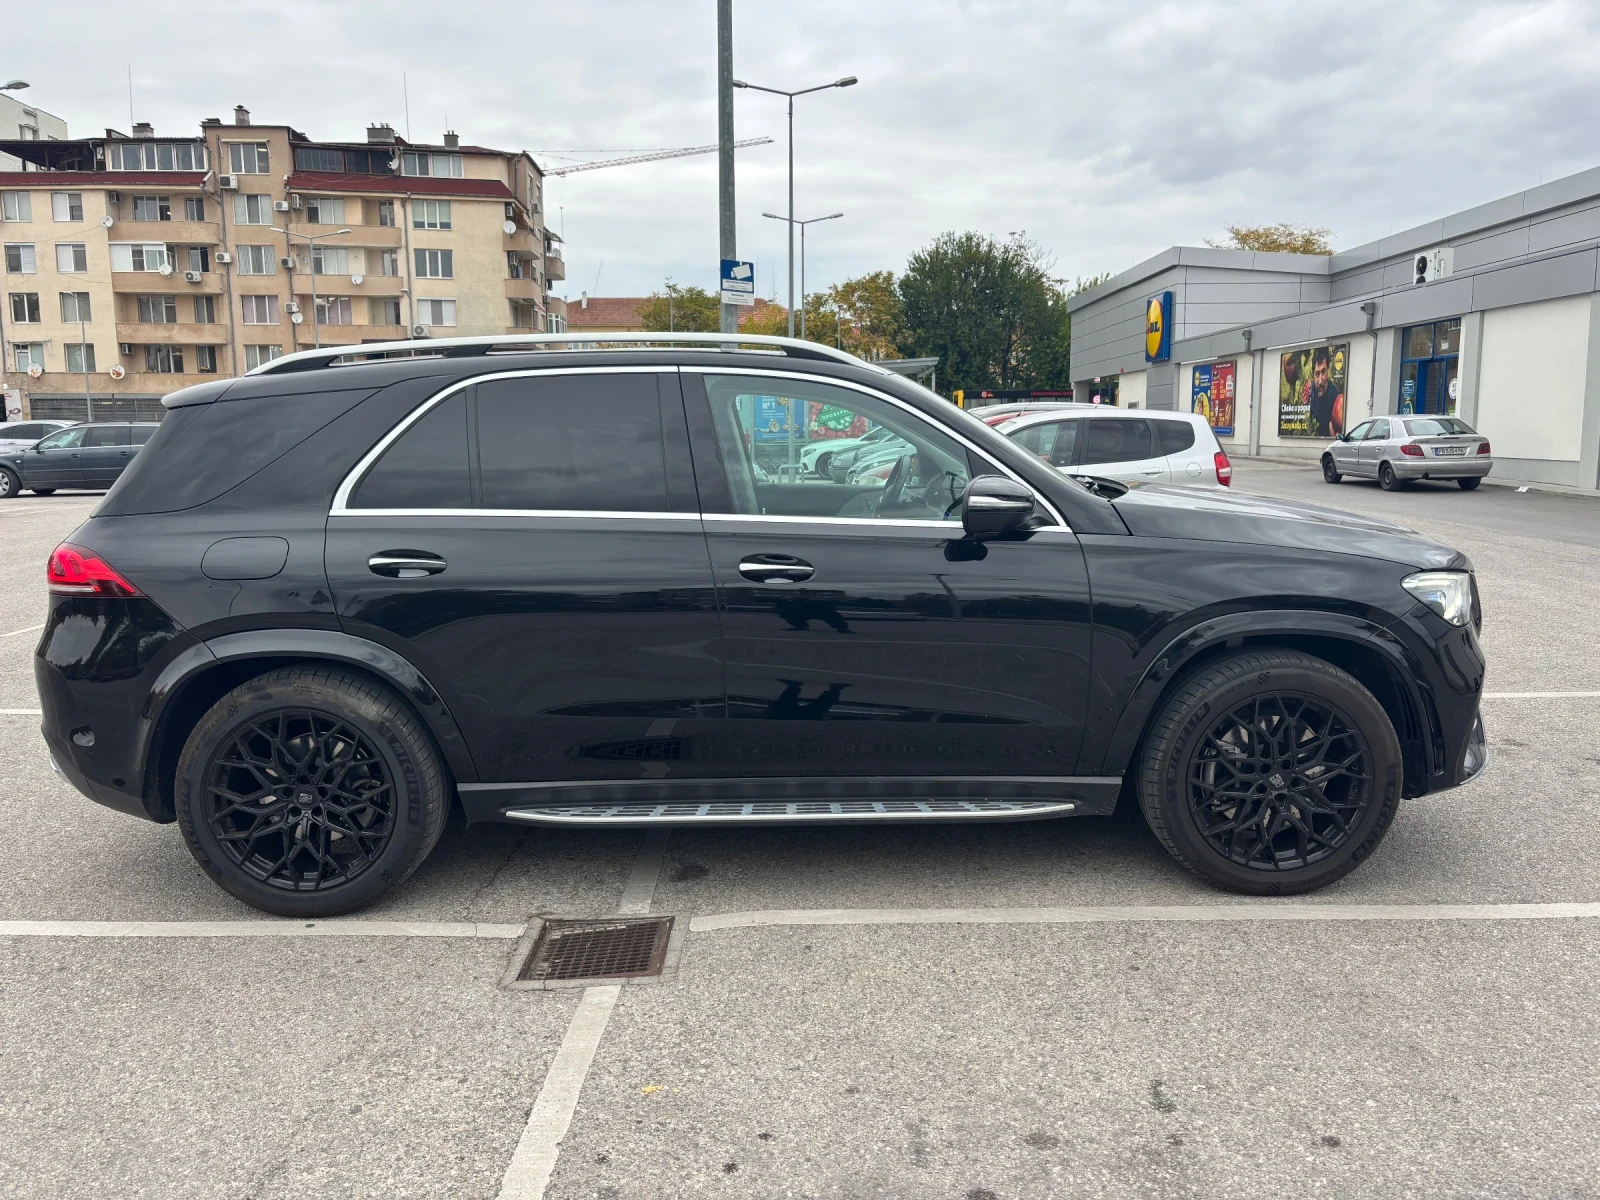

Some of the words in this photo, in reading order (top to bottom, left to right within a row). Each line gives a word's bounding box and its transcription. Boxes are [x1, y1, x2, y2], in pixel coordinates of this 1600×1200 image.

[186, 751, 196, 774] PILOT
[195, 728, 212, 750] SPORT
[1167, 705, 1207, 780] MICHELIN
[392, 742, 419, 824] MICHELIN
[181, 781, 209, 864] MICHELIN
[1356, 784, 1395, 859] MICHELIN
